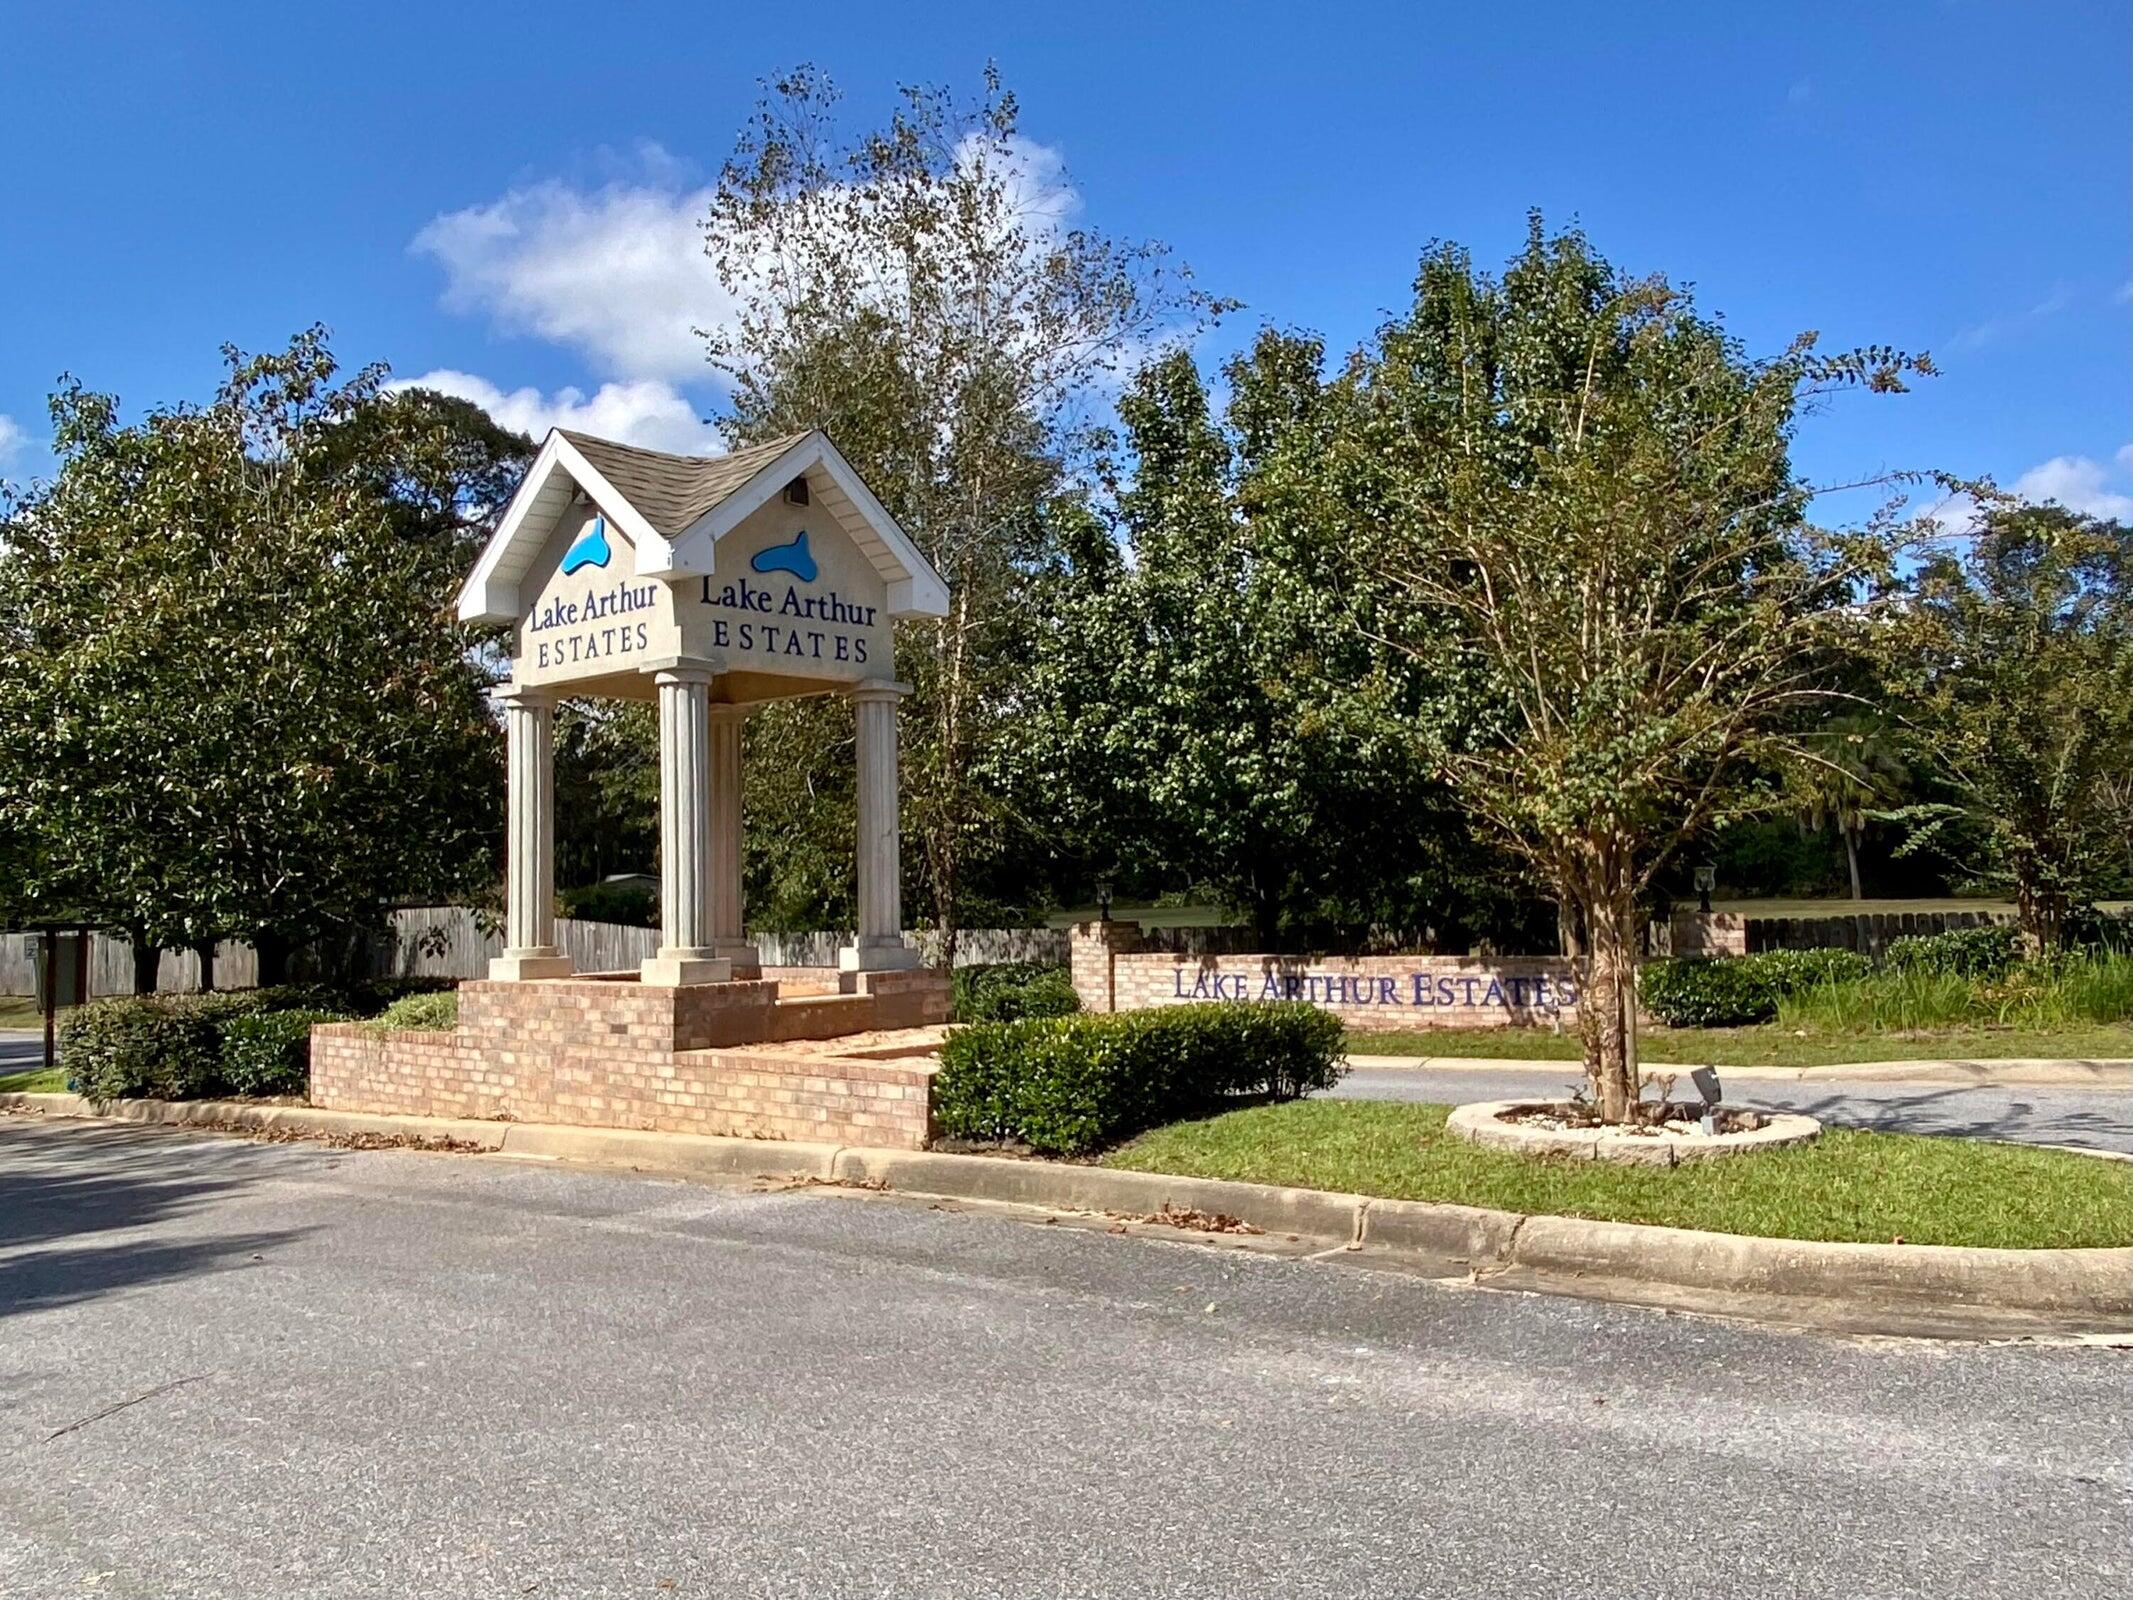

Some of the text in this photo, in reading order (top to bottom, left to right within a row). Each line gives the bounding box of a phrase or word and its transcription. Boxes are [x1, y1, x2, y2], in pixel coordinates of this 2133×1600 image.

[530, 581, 658, 633] Lake Arthur
[700, 575, 877, 627] Lake Arthur
[538, 622, 648, 669] ESTATES
[712, 620, 868, 664] ESTATES
[1173, 968, 1579, 1006] LAKE ARTHUR ESTATES
